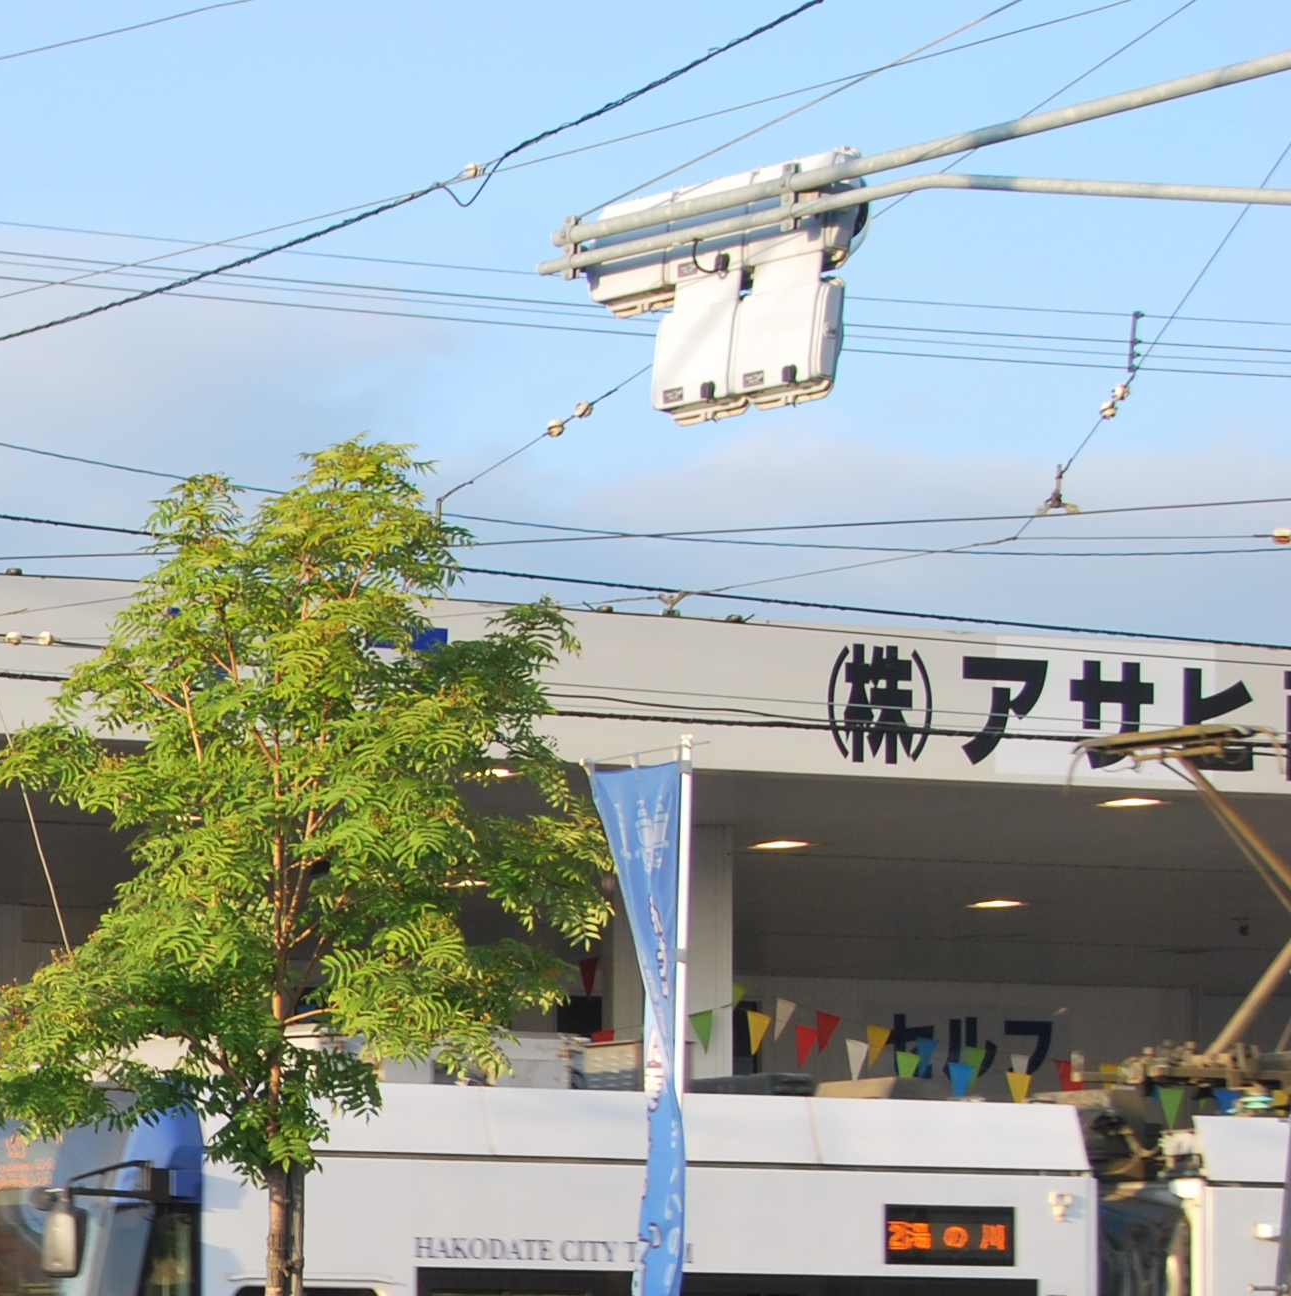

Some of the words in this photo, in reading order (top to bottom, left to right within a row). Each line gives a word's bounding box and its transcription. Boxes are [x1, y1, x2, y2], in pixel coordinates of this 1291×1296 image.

[827, 642, 1291, 782] (株)アサヒ
[414, 1236, 554, 1262] HAKODATE
[560, 1240, 617, 1263] CITY
